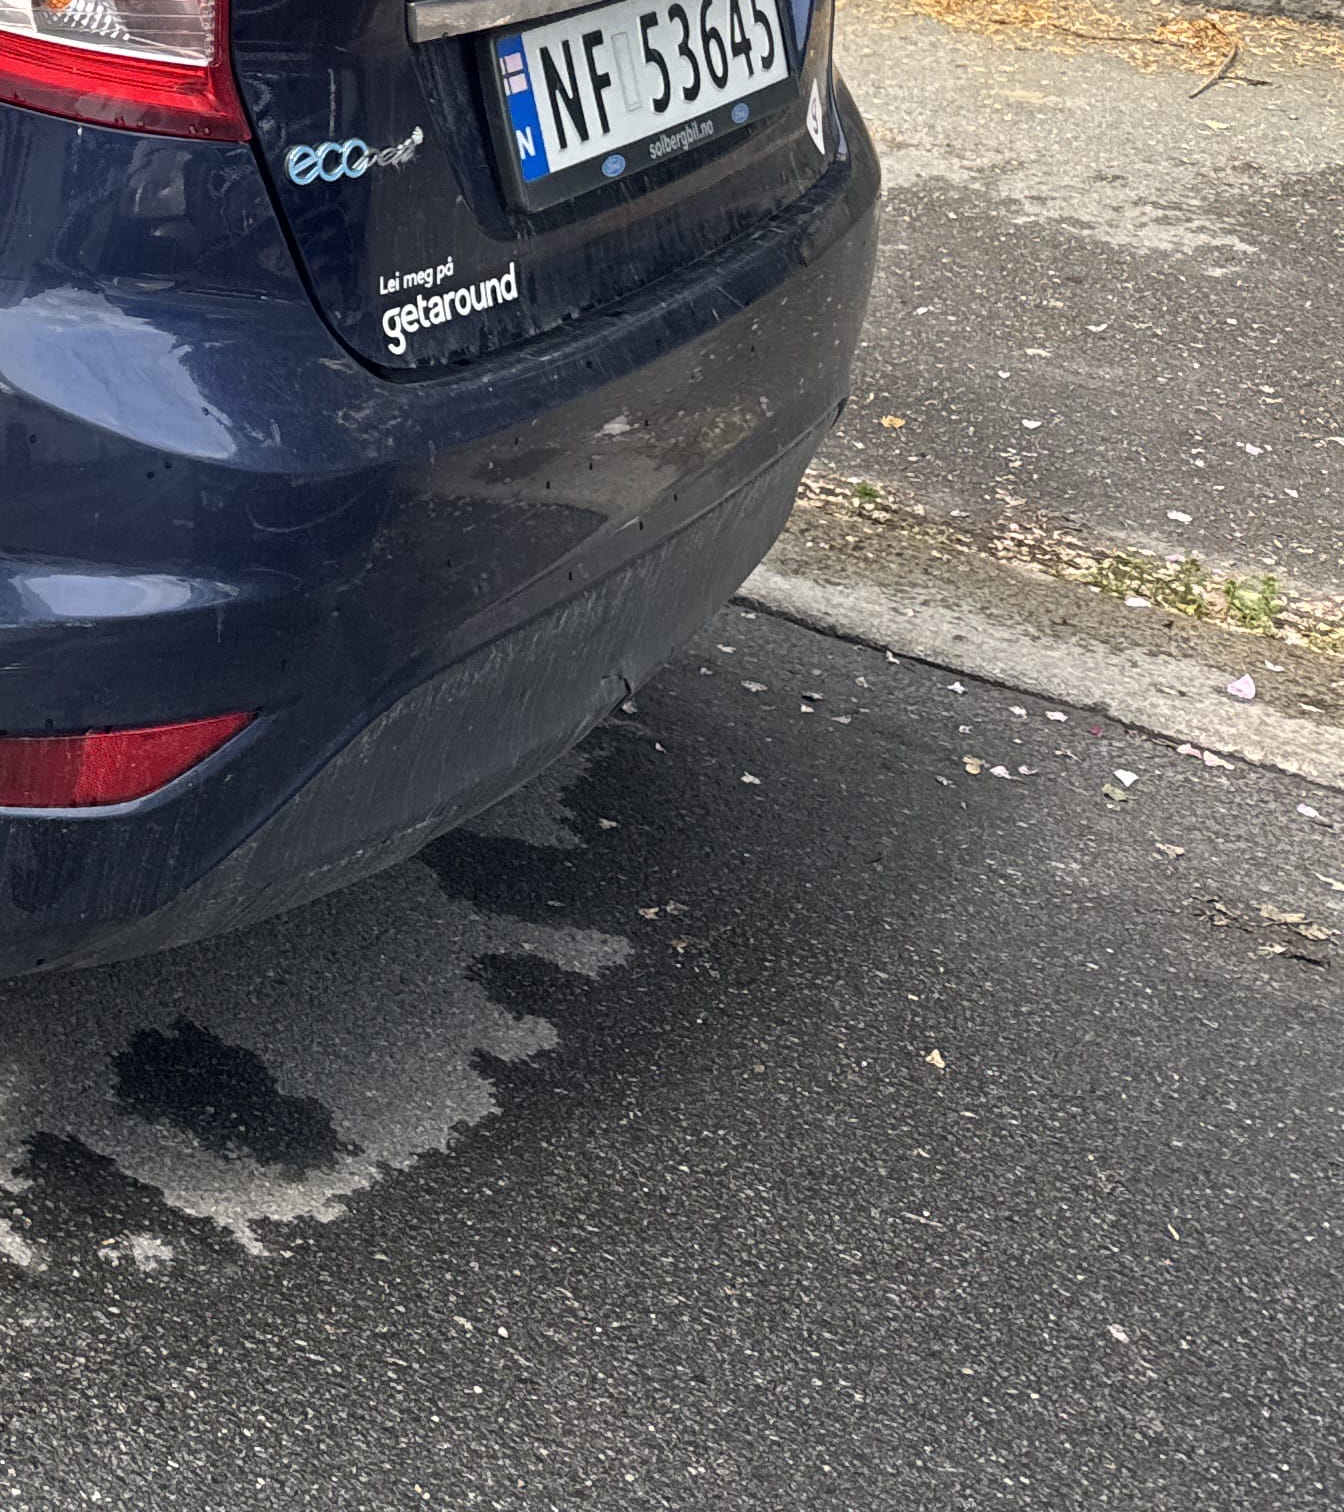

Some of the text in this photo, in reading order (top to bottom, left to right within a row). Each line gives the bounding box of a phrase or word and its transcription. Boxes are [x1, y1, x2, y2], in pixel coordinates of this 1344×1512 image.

[540, 29, 612, 150] NF
[515, 125, 536, 160] N
[649, 119, 714, 159] solbergbil.no
[379, 255, 455, 295] Lei meg på
[382, 261, 519, 355] getaround
